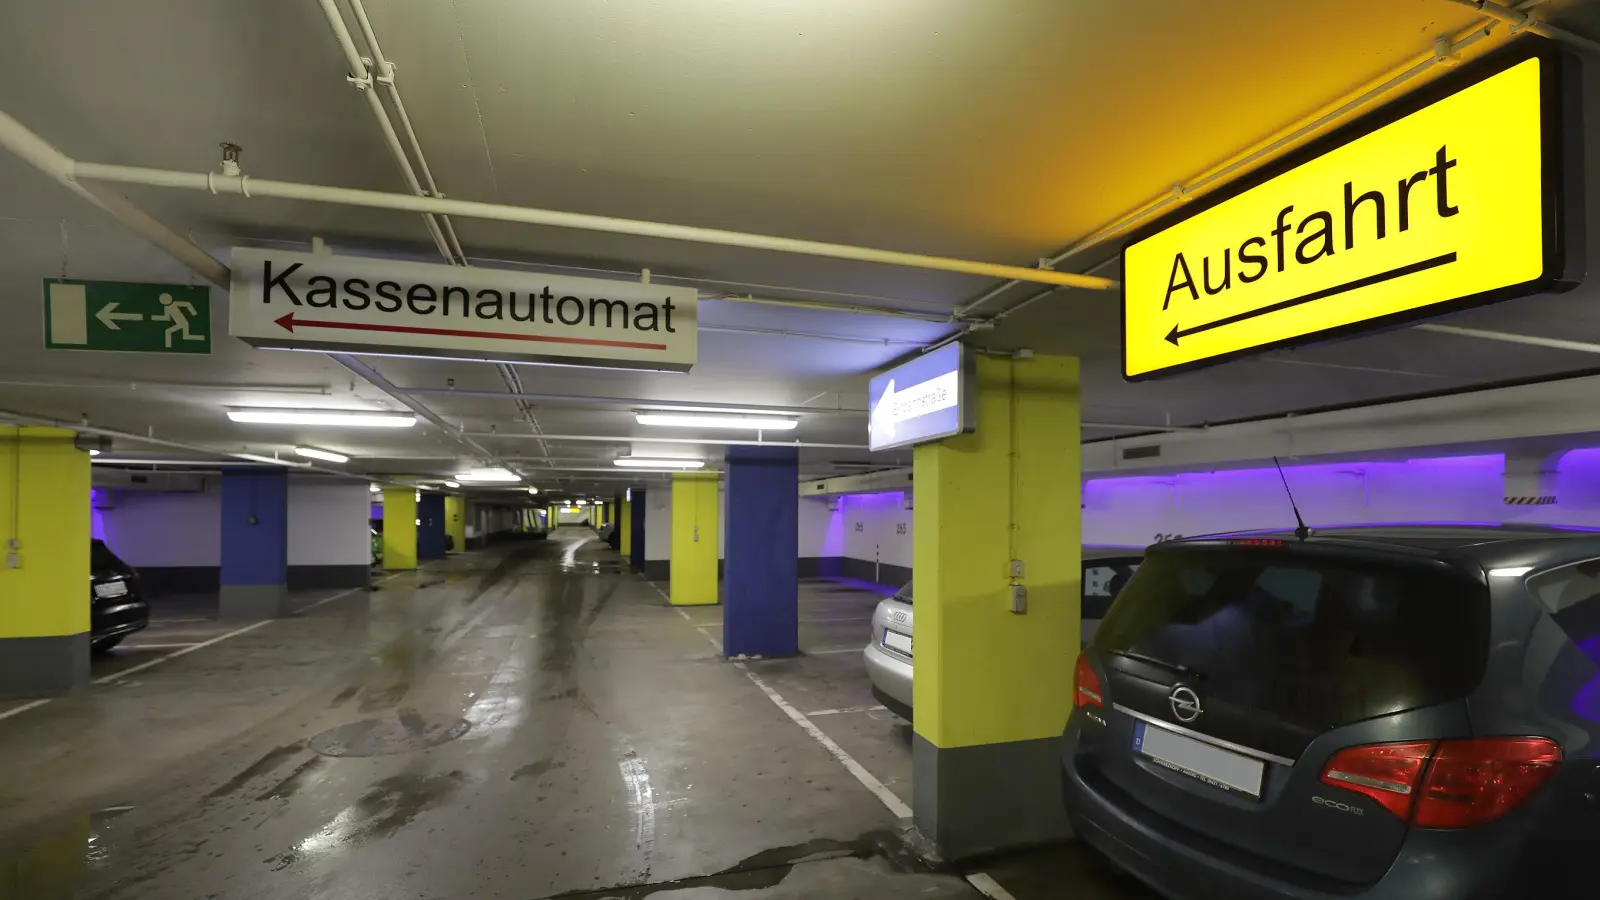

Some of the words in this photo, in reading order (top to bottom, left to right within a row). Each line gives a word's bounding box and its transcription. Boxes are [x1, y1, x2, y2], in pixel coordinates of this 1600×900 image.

[1163, 144, 1459, 311] Ausfahrt
[263, 260, 676, 333] Kassenautomat
[892, 387, 947, 416] Enbahnstraße
